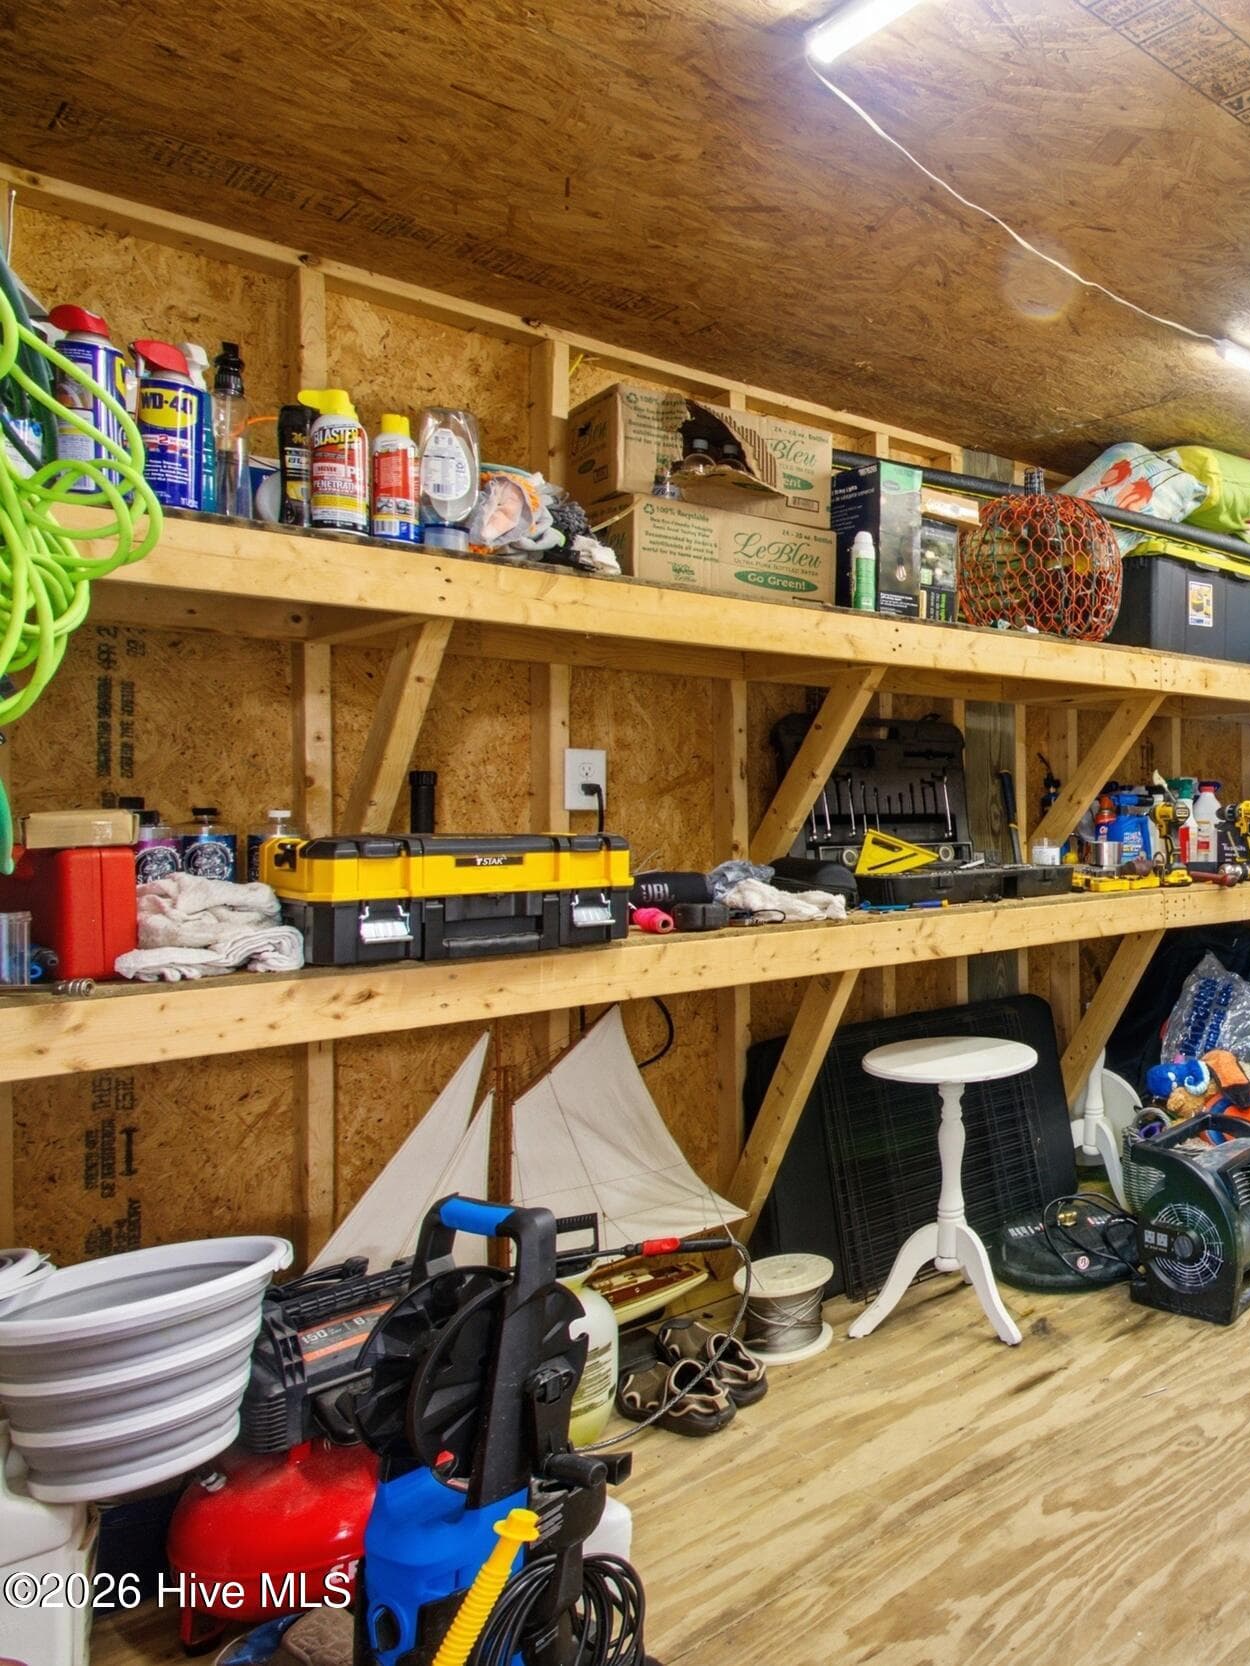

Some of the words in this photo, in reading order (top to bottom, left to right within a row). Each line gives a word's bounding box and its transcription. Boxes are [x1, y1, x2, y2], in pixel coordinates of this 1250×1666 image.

[141, 391, 193, 415] WD-40
[747, 572, 764, 583] Go
[768, 575, 806, 590] Green!
[302, 1328, 328, 1344] 150
